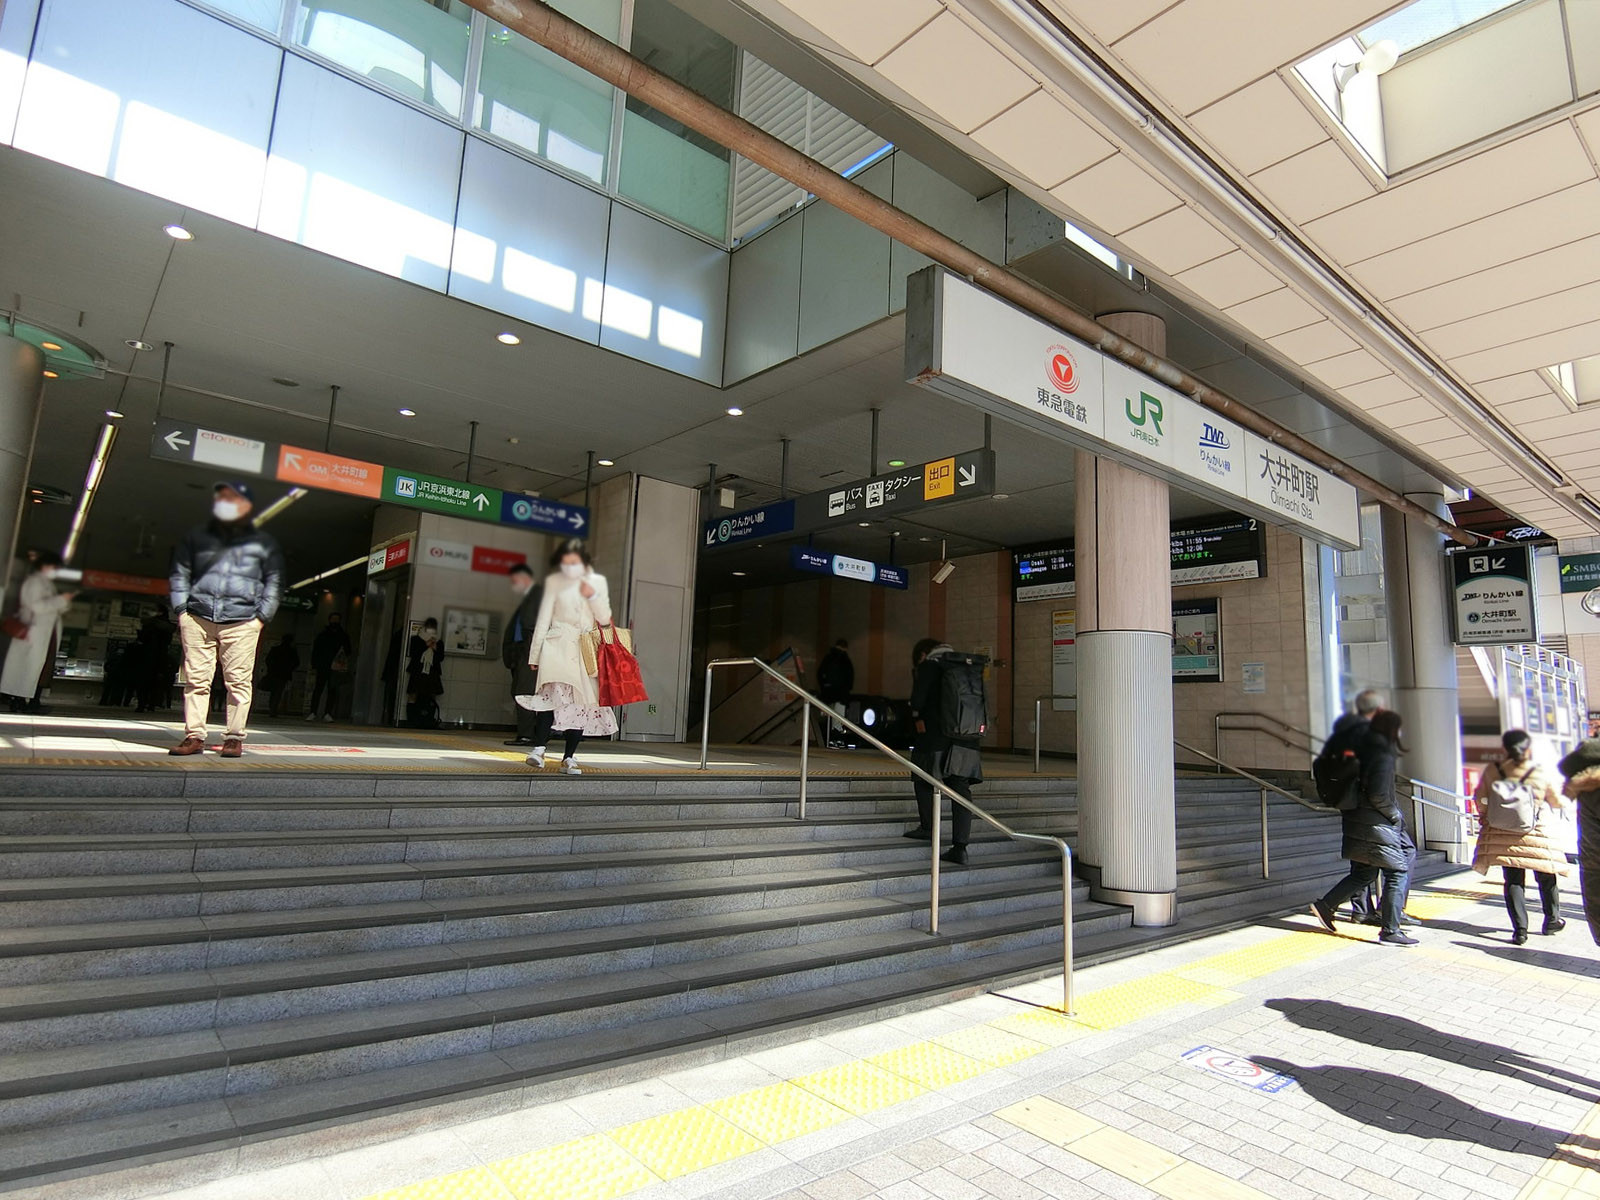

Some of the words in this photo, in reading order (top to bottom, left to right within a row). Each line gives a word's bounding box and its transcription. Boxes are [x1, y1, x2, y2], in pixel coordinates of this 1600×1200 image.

[1037, 387, 1087, 424] 東急電鉄
[1125, 390, 1164, 437] JR
[1199, 422, 1230, 449] TWR
[1200, 449, 1231, 472] りんかい線
[929, 465, 950, 481] 出口
[1260, 448, 1319, 505] 大井町駅
[400, 481, 413, 494] JK
[417, 481, 470, 500] JR京浜東北線
[867, 481, 883, 492] TAXI
[886, 474, 922, 493] タクシー
[929, 482, 941, 491] Exit
[846, 487, 863, 501] バス
[846, 503, 856, 511] Bus
[731, 511, 765, 529] りんかい線
[1249, 518, 1257, 531] 2
[1562, 573, 1600, 583] 三井住友銀
[1483, 590, 1524, 600] りんかい線
[1482, 609, 1517, 618] 大井町駅
